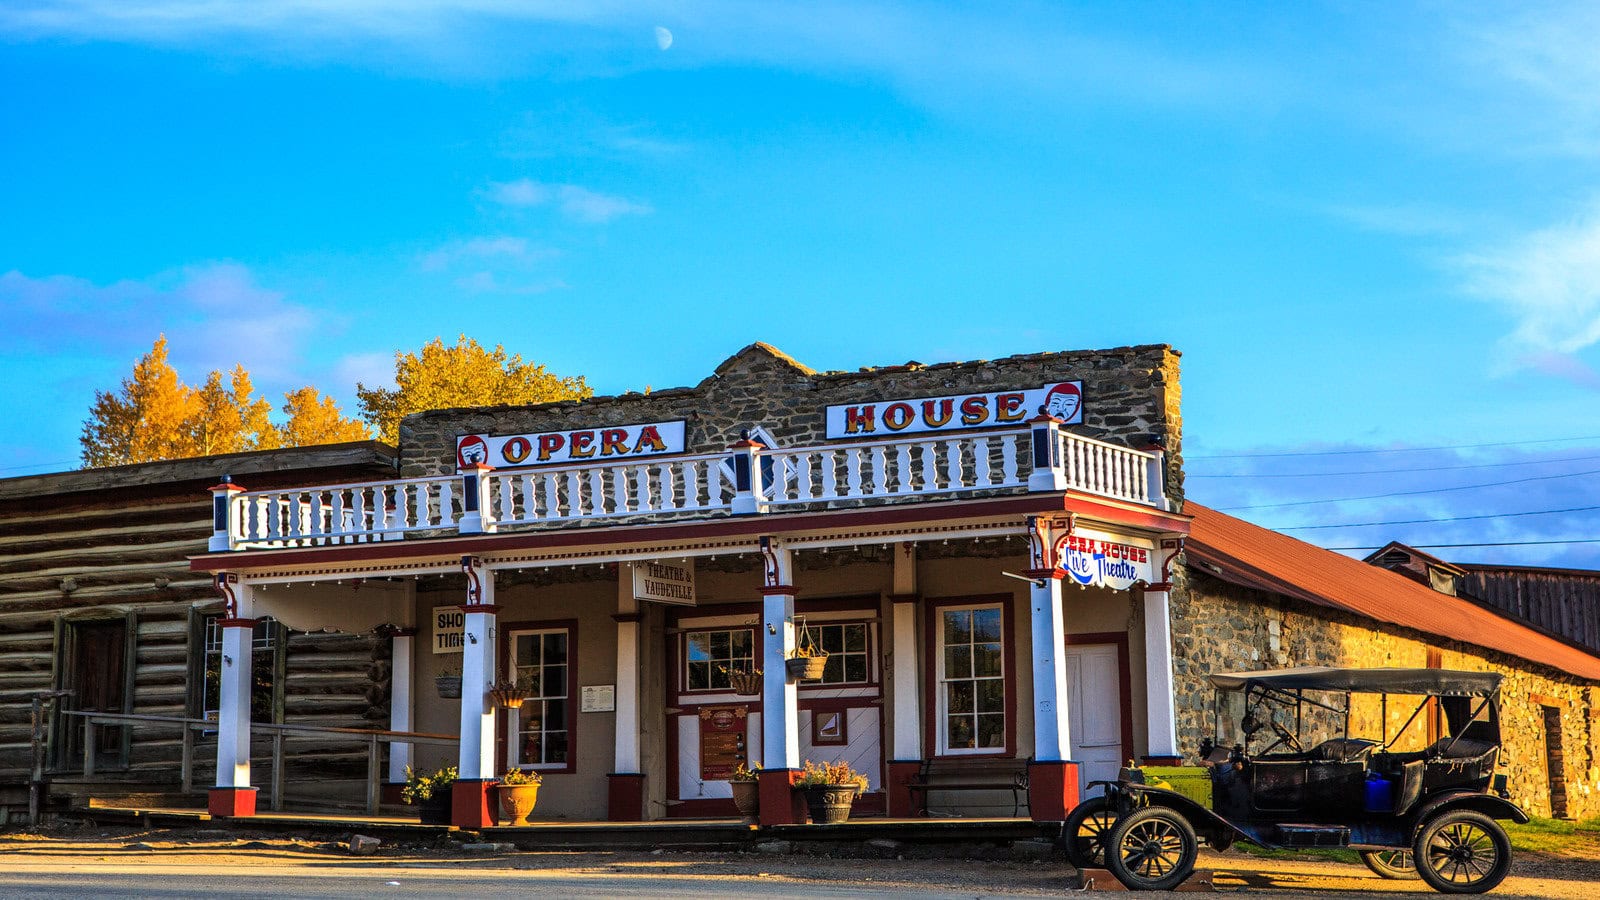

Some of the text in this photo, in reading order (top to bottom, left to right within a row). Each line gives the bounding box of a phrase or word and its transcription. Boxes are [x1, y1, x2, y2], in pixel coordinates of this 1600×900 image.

[501, 393, 1027, 464] OPERA HOUSE
[1060, 535, 1147, 563] ERA HOUSE
[649, 563, 684, 582] THEATRE
[685, 571, 692, 583] &
[1063, 547, 1137, 584] Live Theatre
[644, 579, 693, 600] VAUDEVILLE
[438, 612, 464, 628] SHO
